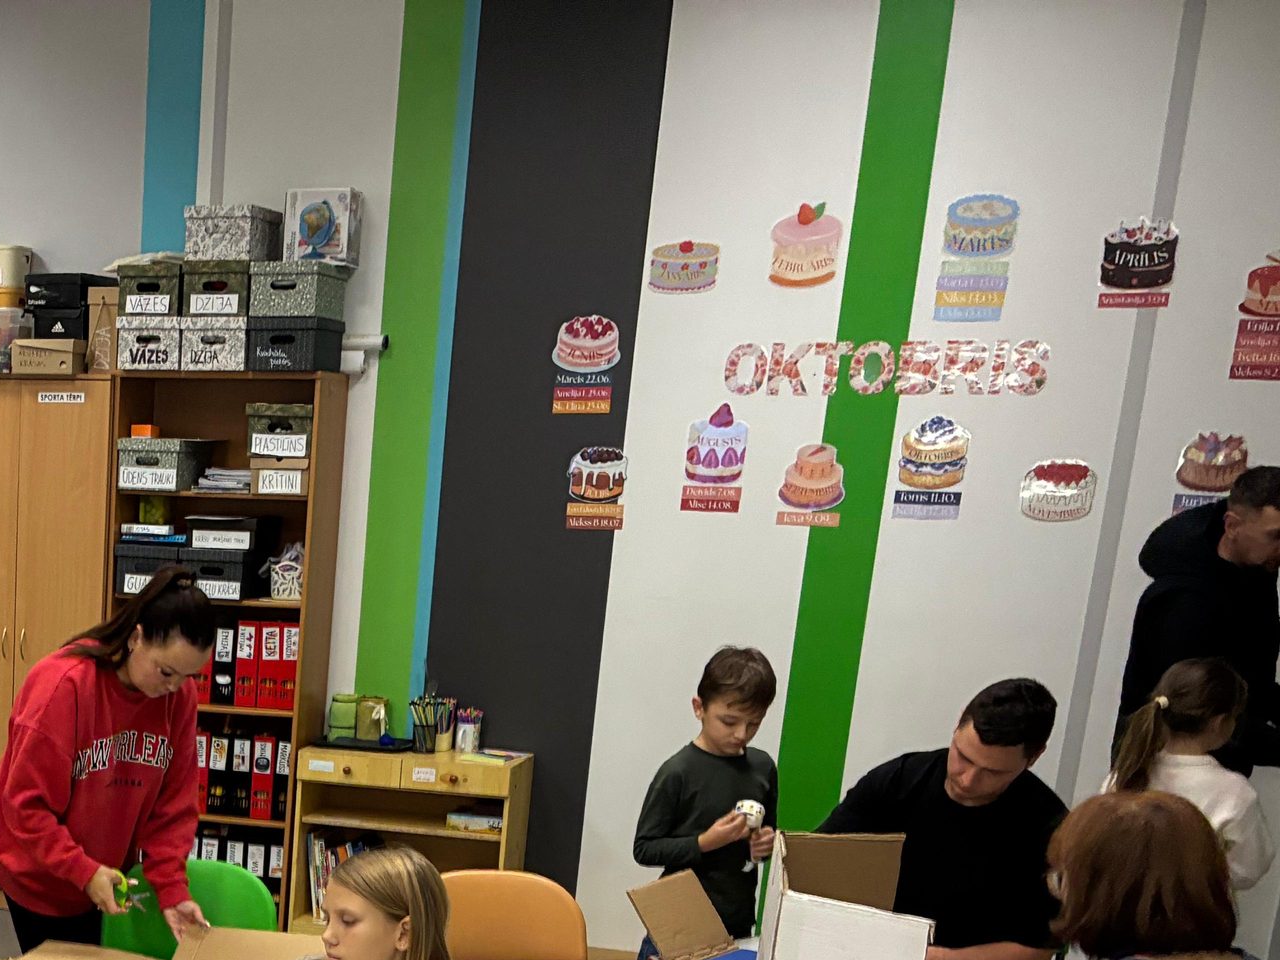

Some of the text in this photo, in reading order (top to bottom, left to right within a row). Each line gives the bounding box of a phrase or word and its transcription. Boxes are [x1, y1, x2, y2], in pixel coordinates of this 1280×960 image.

[130, 296, 167, 312] VĀZES
[129, 345, 169, 365] VĀZES
[723, 339, 1051, 397] OKTOBRIS
[696, 435, 742, 447] AUGUSTS
[123, 467, 174, 486] ŪDENS TRAUKI
[899, 492, 928, 503] Toms
[265, 630, 277, 658] KEITA
